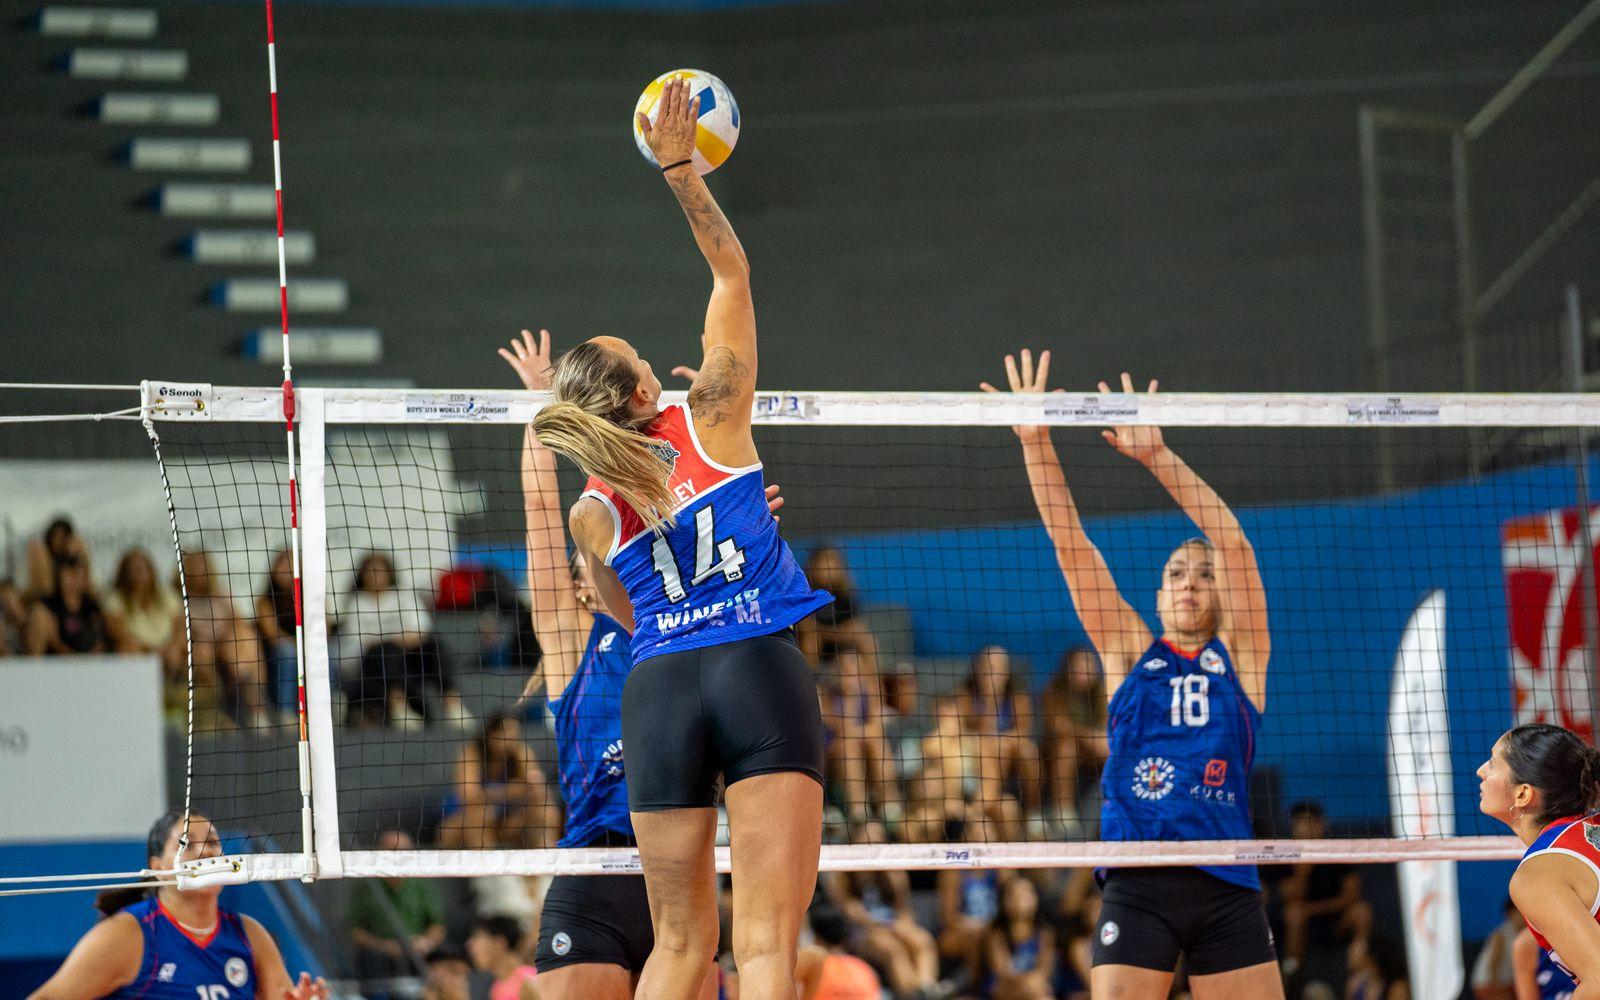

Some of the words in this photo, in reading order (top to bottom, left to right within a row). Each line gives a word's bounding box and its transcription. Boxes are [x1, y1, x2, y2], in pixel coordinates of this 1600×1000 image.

[168, 388, 202, 397] Senoh
[462, 406, 509, 414] CHIONSHIP
[651, 504, 747, 604] 14
[1169, 673, 1210, 727] 18
[946, 851, 969, 860] FIVB
